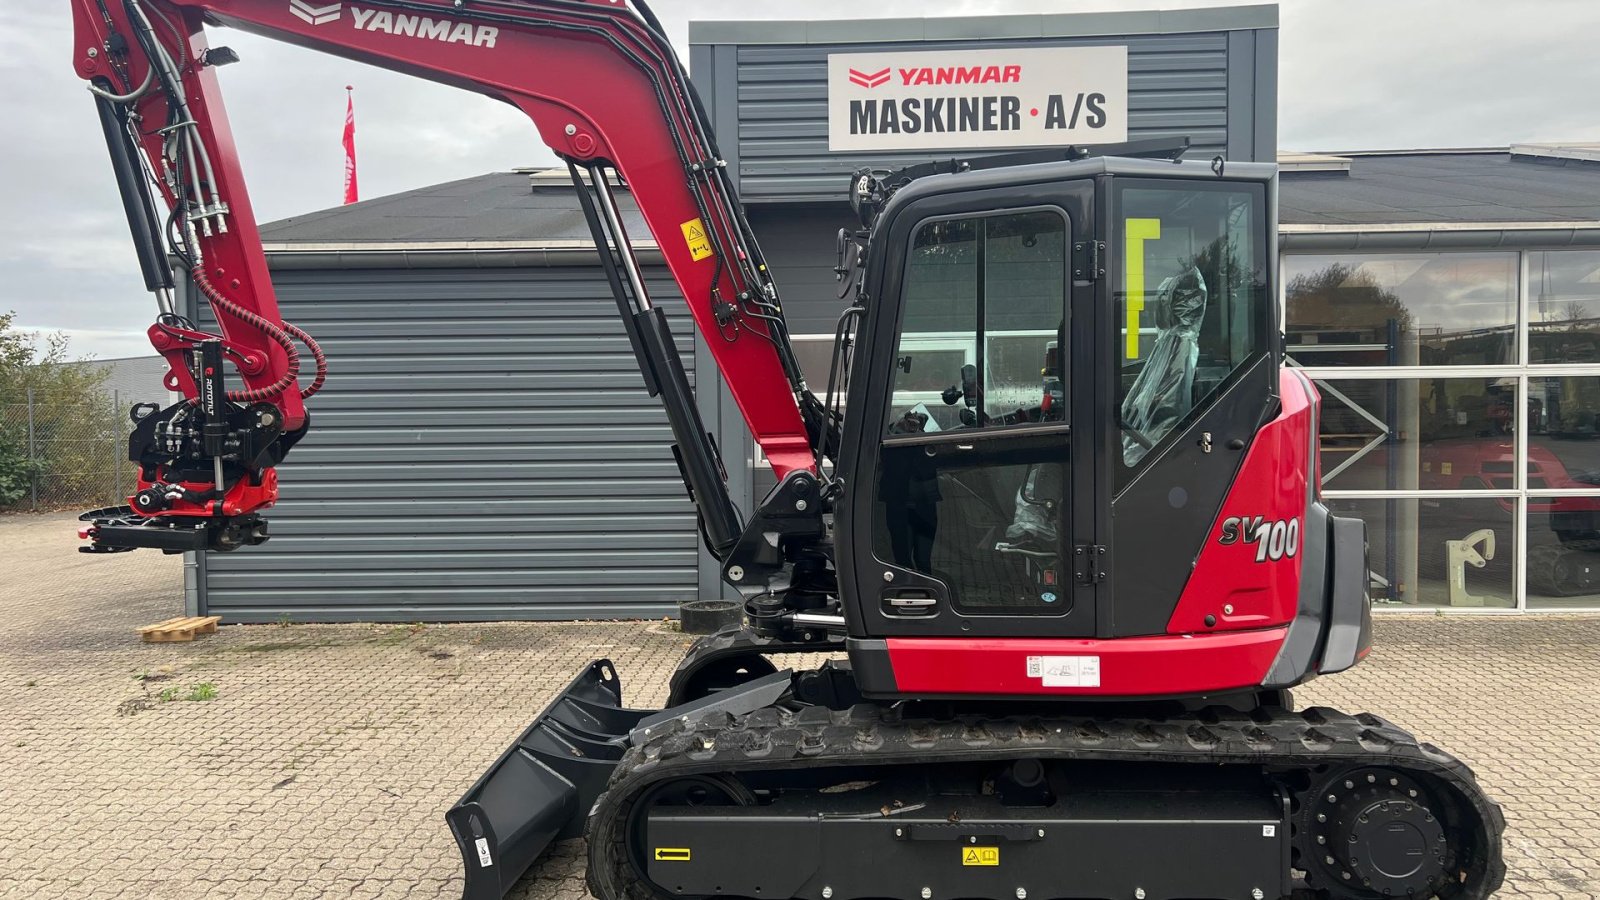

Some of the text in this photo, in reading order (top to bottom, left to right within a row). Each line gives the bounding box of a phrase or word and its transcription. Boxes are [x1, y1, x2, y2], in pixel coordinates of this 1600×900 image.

[351, 7, 499, 48] YANMAR
[899, 65, 1021, 86] YANMAR
[849, 93, 1107, 135] MASKINER A/S
[206, 378, 214, 416] ROTOTILT
